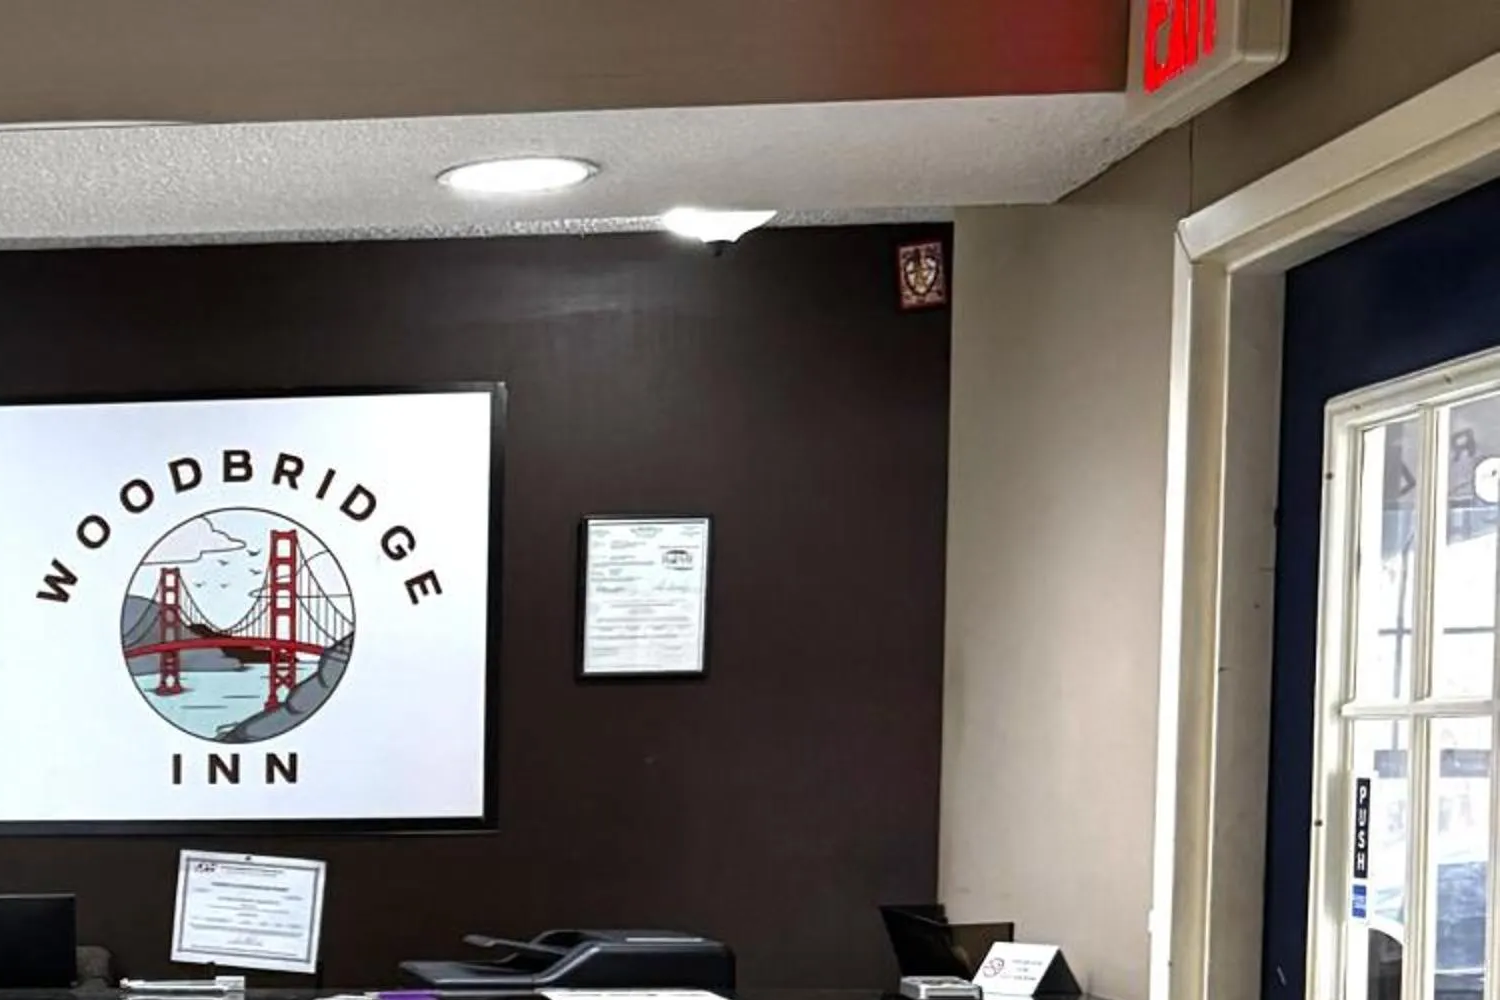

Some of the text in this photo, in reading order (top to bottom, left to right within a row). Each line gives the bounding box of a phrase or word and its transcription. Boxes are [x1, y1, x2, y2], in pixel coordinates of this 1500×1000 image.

[35, 449, 443, 605] WOODBRIDGE
[171, 752, 298, 785] INN
[1357, 786, 1368, 871] PUSH
